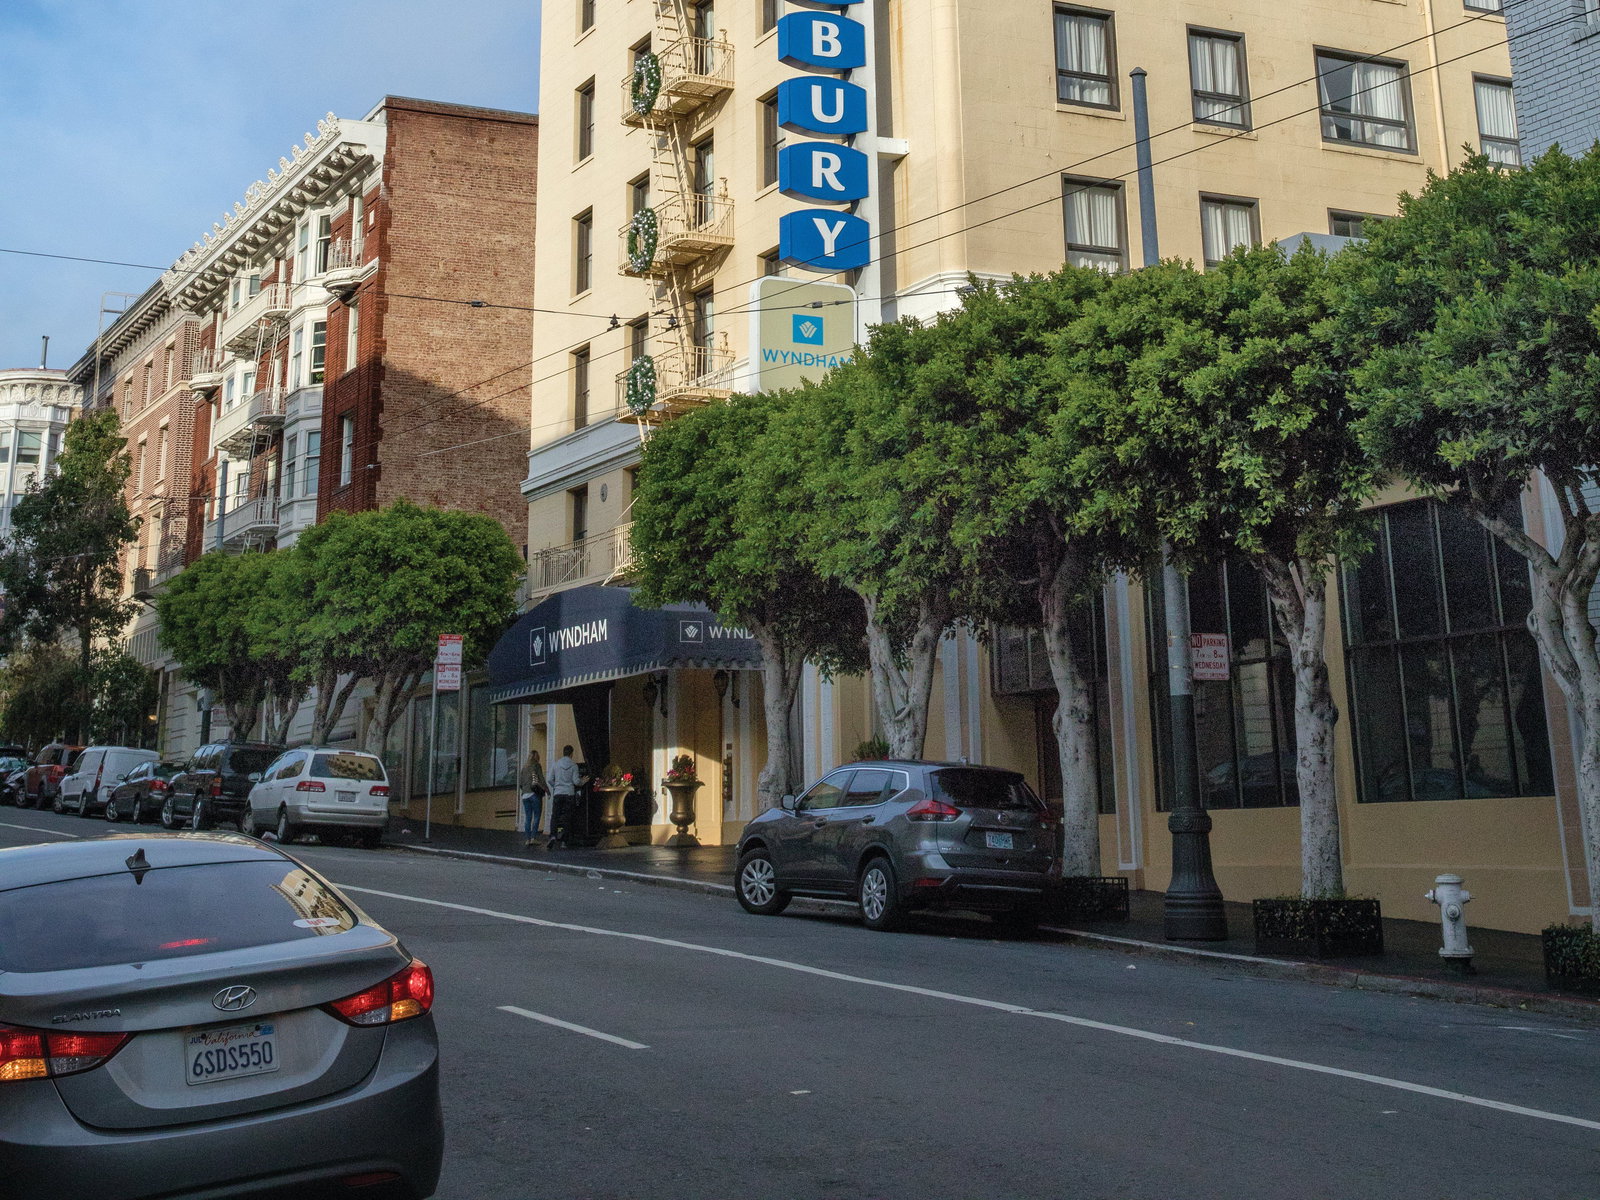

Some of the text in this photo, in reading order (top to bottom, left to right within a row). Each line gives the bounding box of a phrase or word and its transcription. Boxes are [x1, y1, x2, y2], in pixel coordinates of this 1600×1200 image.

[548, 618, 608, 653] WYNDHAM
[1191, 635, 1226, 647] NO PARKING
[1194, 661, 1226, 669] WEDNESDAY
[52, 1008, 121, 1024] ELANTRA
[204, 1031, 256, 1046] California
[192, 1041, 273, 1077] 6SDS550
